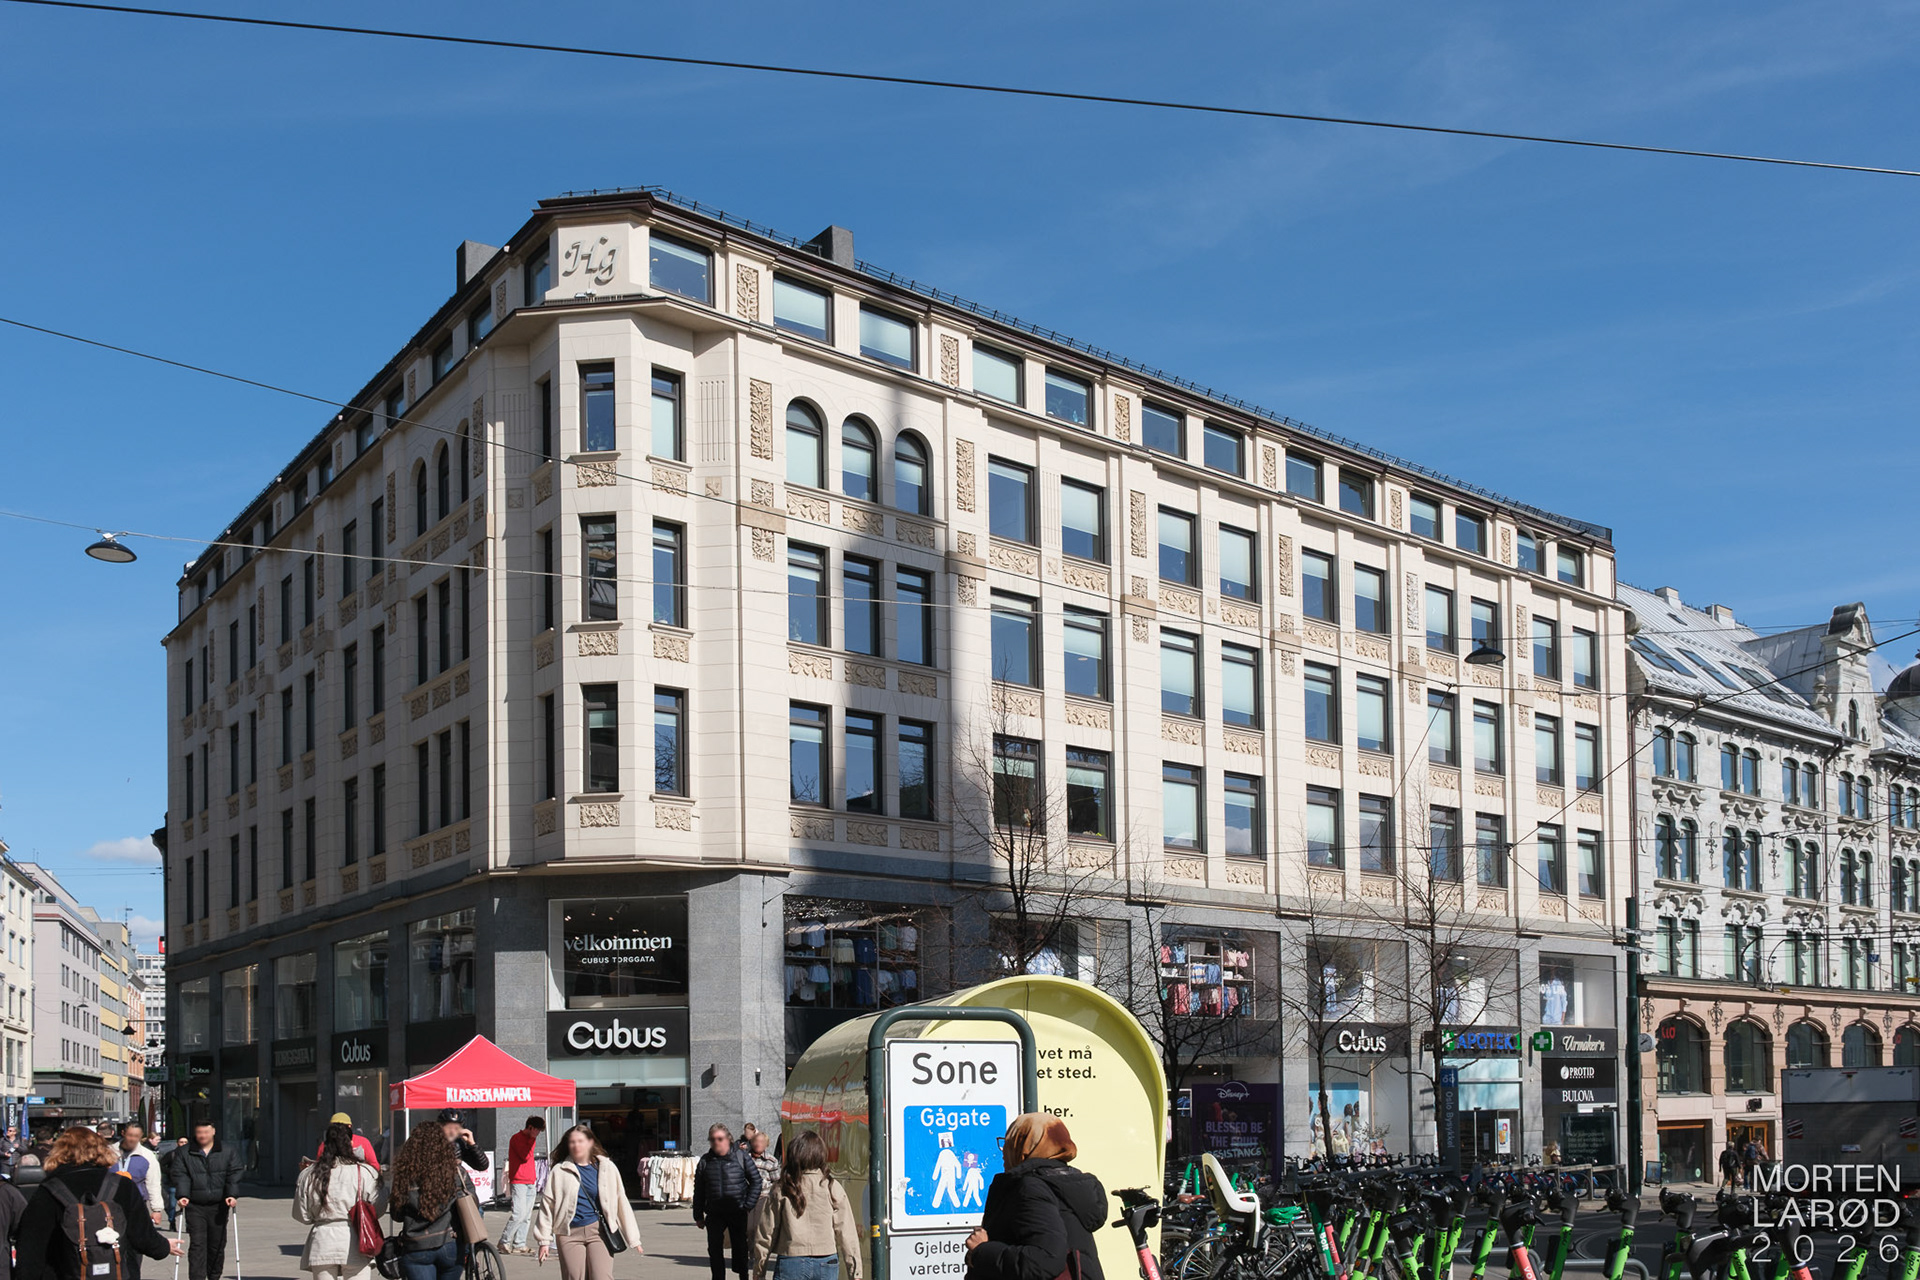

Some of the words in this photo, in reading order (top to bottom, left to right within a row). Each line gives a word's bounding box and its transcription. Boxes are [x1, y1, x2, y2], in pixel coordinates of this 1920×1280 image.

[564, 934, 672, 952] velkommen
[567, 1018, 667, 1050] Cubus
[1339, 1029, 1387, 1052] Cubus
[341, 1037, 371, 1063] Cubus
[1069, 1045, 1092, 1060] må
[911, 1052, 998, 1085] Sone
[1057, 1066, 1096, 1079] sted.
[1569, 1067, 1595, 1076] PROTID
[446, 1087, 532, 1102] KLASSEKAMPEN
[1445, 1091, 1455, 1111] Oslo
[1562, 1090, 1595, 1102] BULOVA
[920, 1107, 991, 1131] Gågate
[1043, 1105, 1074, 1118] her.
[1205, 1122, 1248, 1133] BLESSED
[1250, 1122, 1265, 1133] BE
[1445, 1112, 1456, 1148] Bysykkel
[1210, 1136, 1228, 1147] THE
[1319, 1231, 1329, 1251] Bolt
[1906, 1254, 1916, 1276] ryde
